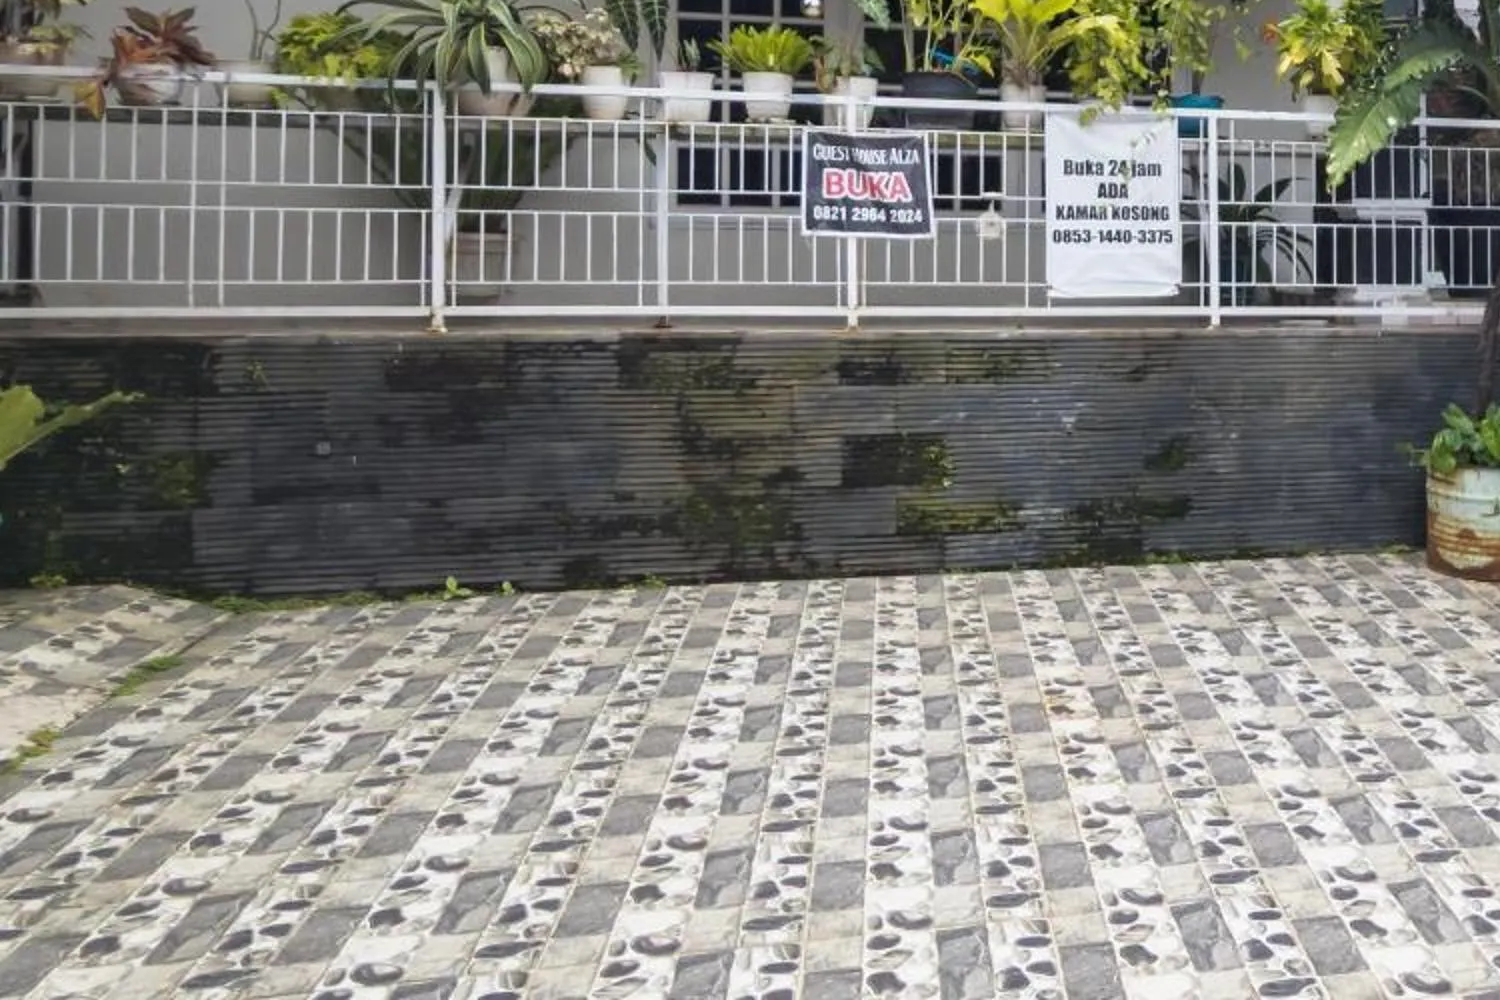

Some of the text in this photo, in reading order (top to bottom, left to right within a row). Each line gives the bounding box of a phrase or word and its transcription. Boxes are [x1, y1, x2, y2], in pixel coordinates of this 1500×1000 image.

[890, 148, 919, 164] ALZA
[1063, 159, 1105, 177] Buka
[1131, 159, 1162, 178] jam
[823, 168, 913, 203] BUKA
[1097, 183, 1129, 199] ADA
[813, 206, 847, 221] 0821
[889, 209, 923, 224] 2024
[1056, 204, 1170, 221] KAMAR KOSONG
[1053, 229, 1173, 244] 0853-1440-3375
